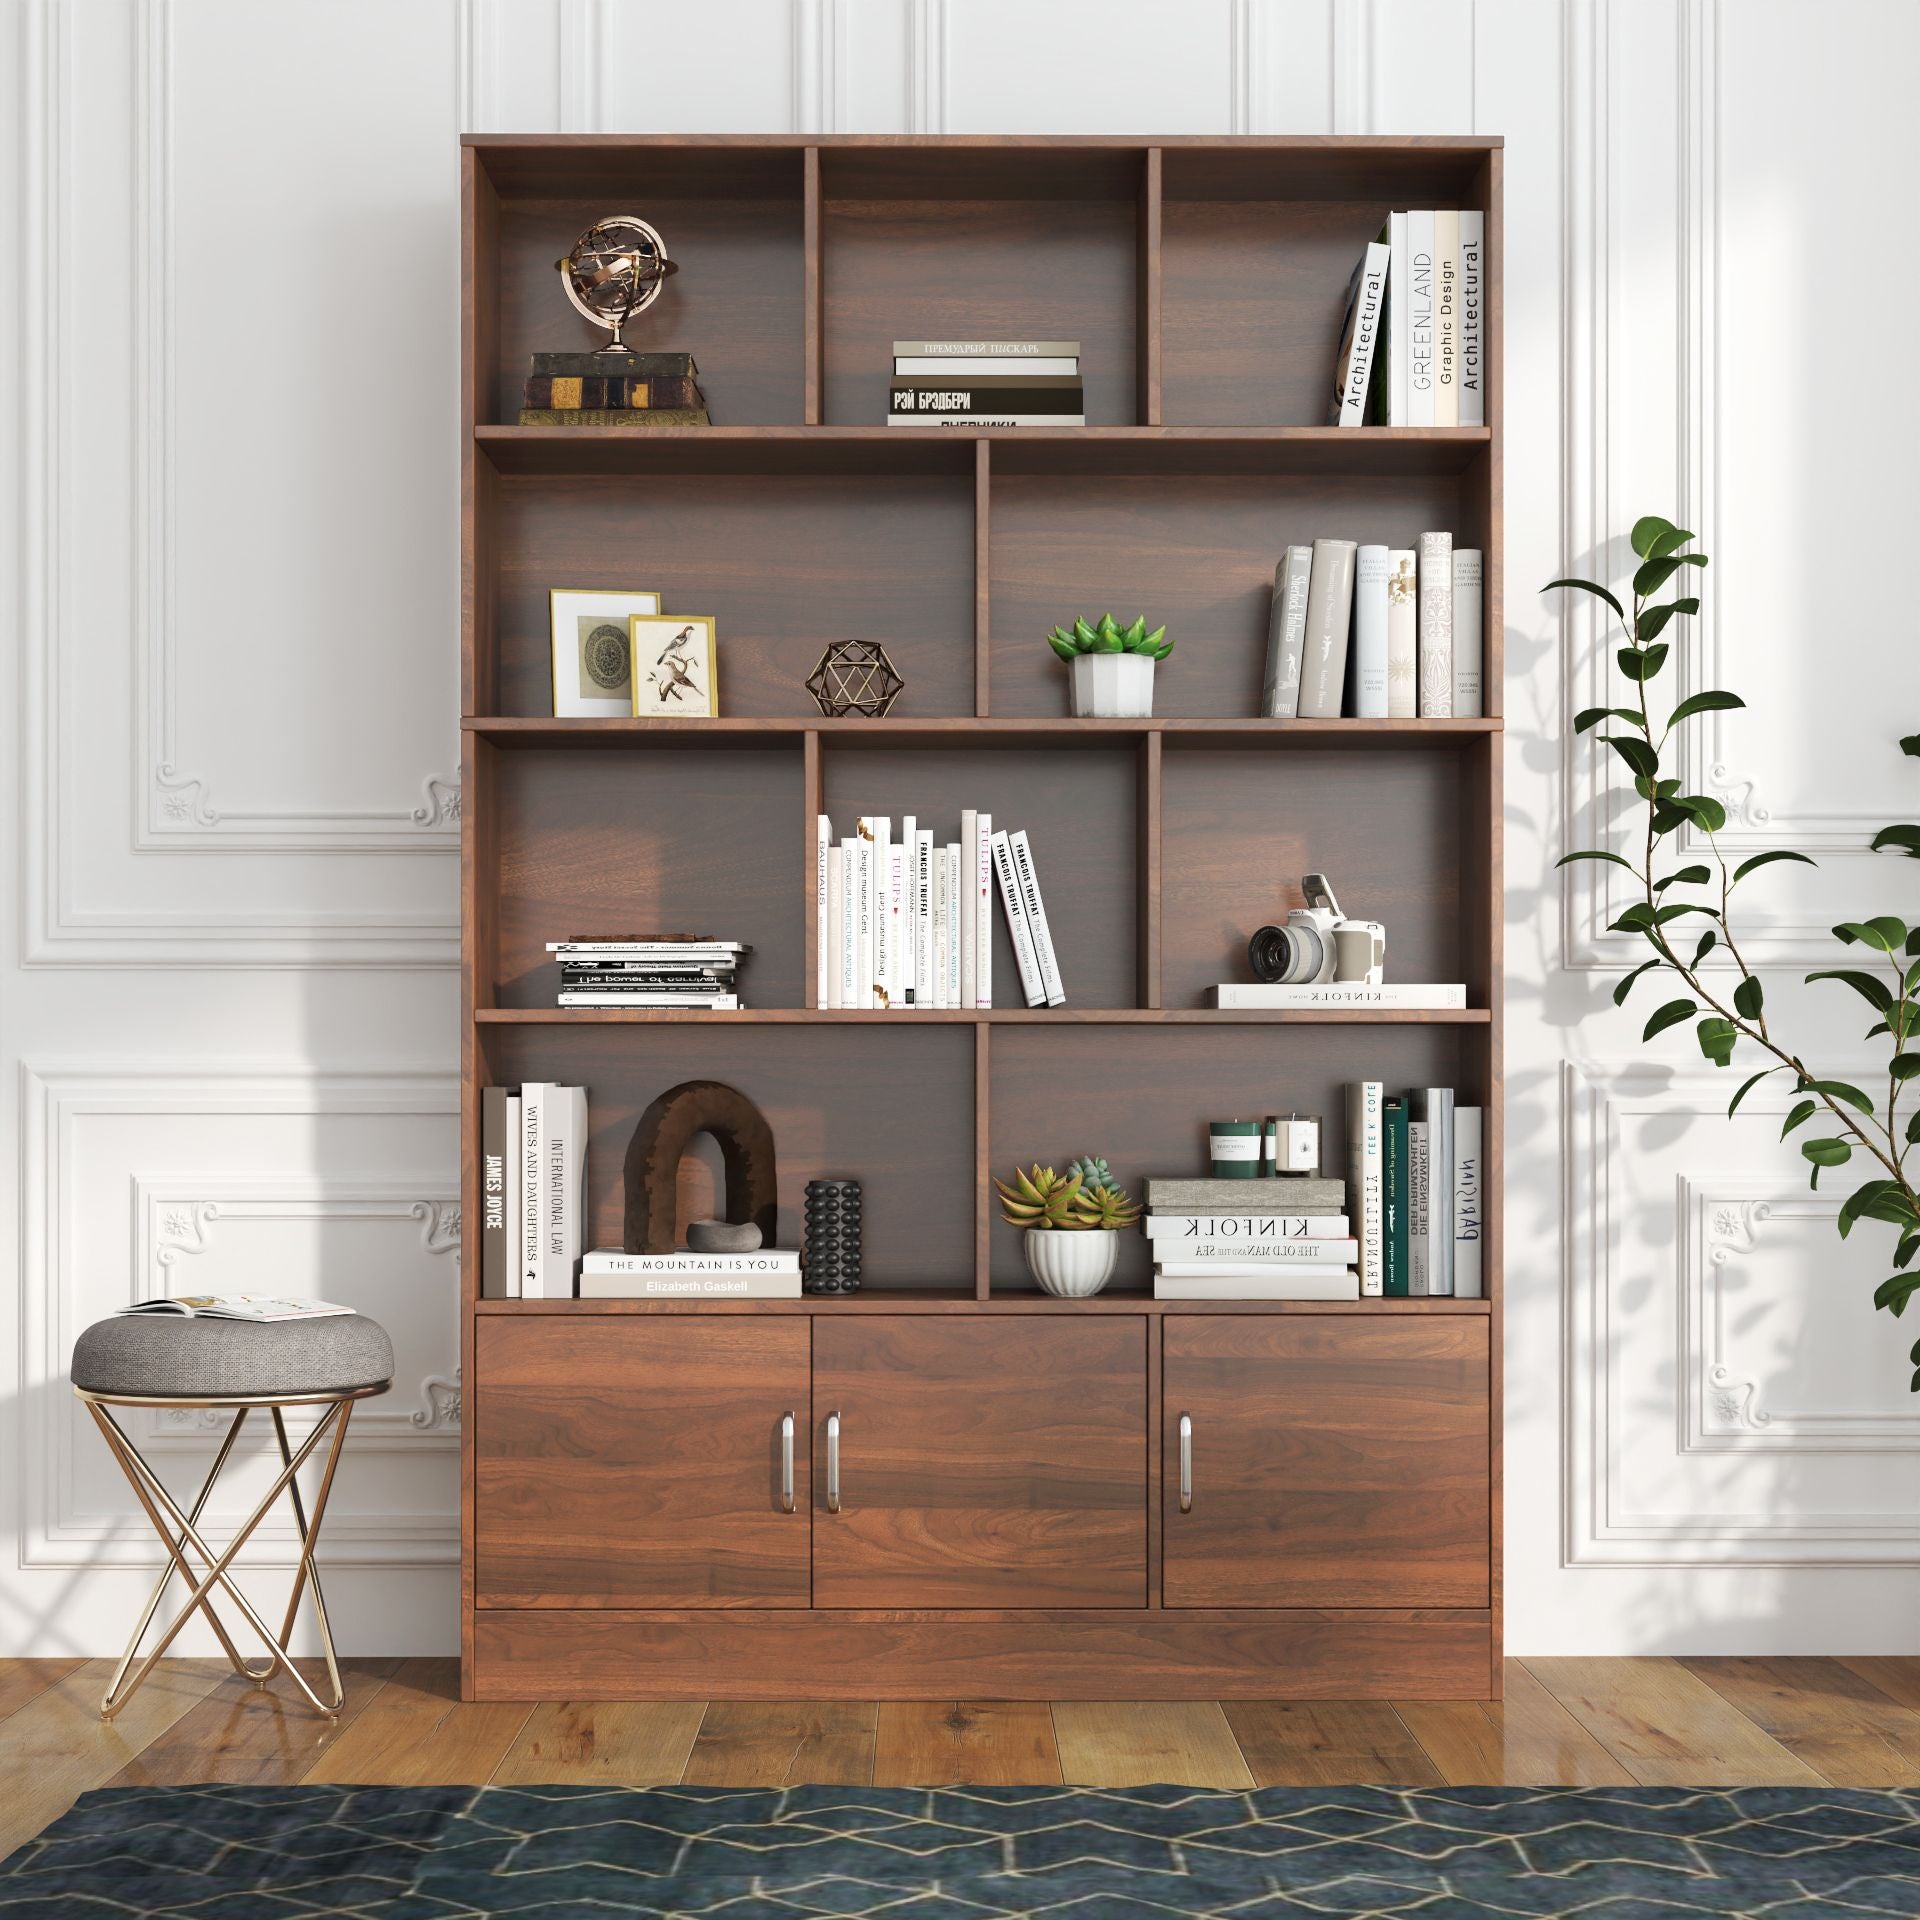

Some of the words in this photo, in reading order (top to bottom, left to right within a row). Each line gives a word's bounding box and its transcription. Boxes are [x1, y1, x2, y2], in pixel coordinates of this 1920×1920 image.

[1441, 260, 1455, 315] Design
[1413, 253, 1432, 390] GREENLAND
[1464, 241, 1478, 390] Architectural
[924, 343, 986, 354] ПРЕМУДРЫЙ
[1347, 272, 1381, 408] Architectural
[1441, 322, 1455, 385] Graphic
[894, 389, 914, 410] РЭЙ
[919, 392, 970, 411] БРЭДБЕРИ
[1288, 575, 1306, 610] Sherlock
[1286, 614, 1304, 642] Holmes
[859, 850, 868, 877] Design
[920, 842, 928, 881] FRANCOIS
[981, 827, 989, 884] TULIPS
[996, 843, 1012, 881] FRANCOIS
[1016, 843, 1031, 881] FRANCOIS
[818, 841, 826, 906] BAUHAUS
[892, 855, 901, 904] TULIPS
[878, 892, 886, 911] Gent
[920, 883, 928, 917] TRUFFAT
[1006, 883, 1020, 916] TRUFFAT
[1025, 883, 1040, 916] TRUFFAT
[1015, 920, 1023, 932] The
[1034, 920, 1043, 932] The
[878, 949, 886, 976] Design
[918, 935, 926, 967] Complete
[1017, 933, 1029, 965] Complete
[1036, 933, 1049, 965] Complete
[1025, 965, 1034, 983] Films
[1045, 965, 1053, 983] Films
[527, 1105, 537, 1147] WIVES
[486, 1155, 502, 1192] JAMES
[527, 1150, 537, 1179] AND
[551, 1139, 563, 1228] INTERNATIONAL
[486, 1195, 502, 1229] JOYCE
[527, 1182, 537, 1261] DAUGHTERS
[551, 1232, 563, 1255] LAW
[609, 1261, 634, 1270] THE
[642, 1261, 723, 1270] MOUNTAIN
[729, 1261, 742, 1270] IS
[748, 1261, 780, 1270] YOU
[646, 1281, 701, 1292] Elizabeth
[704, 1281, 748, 1292] Gaskell
